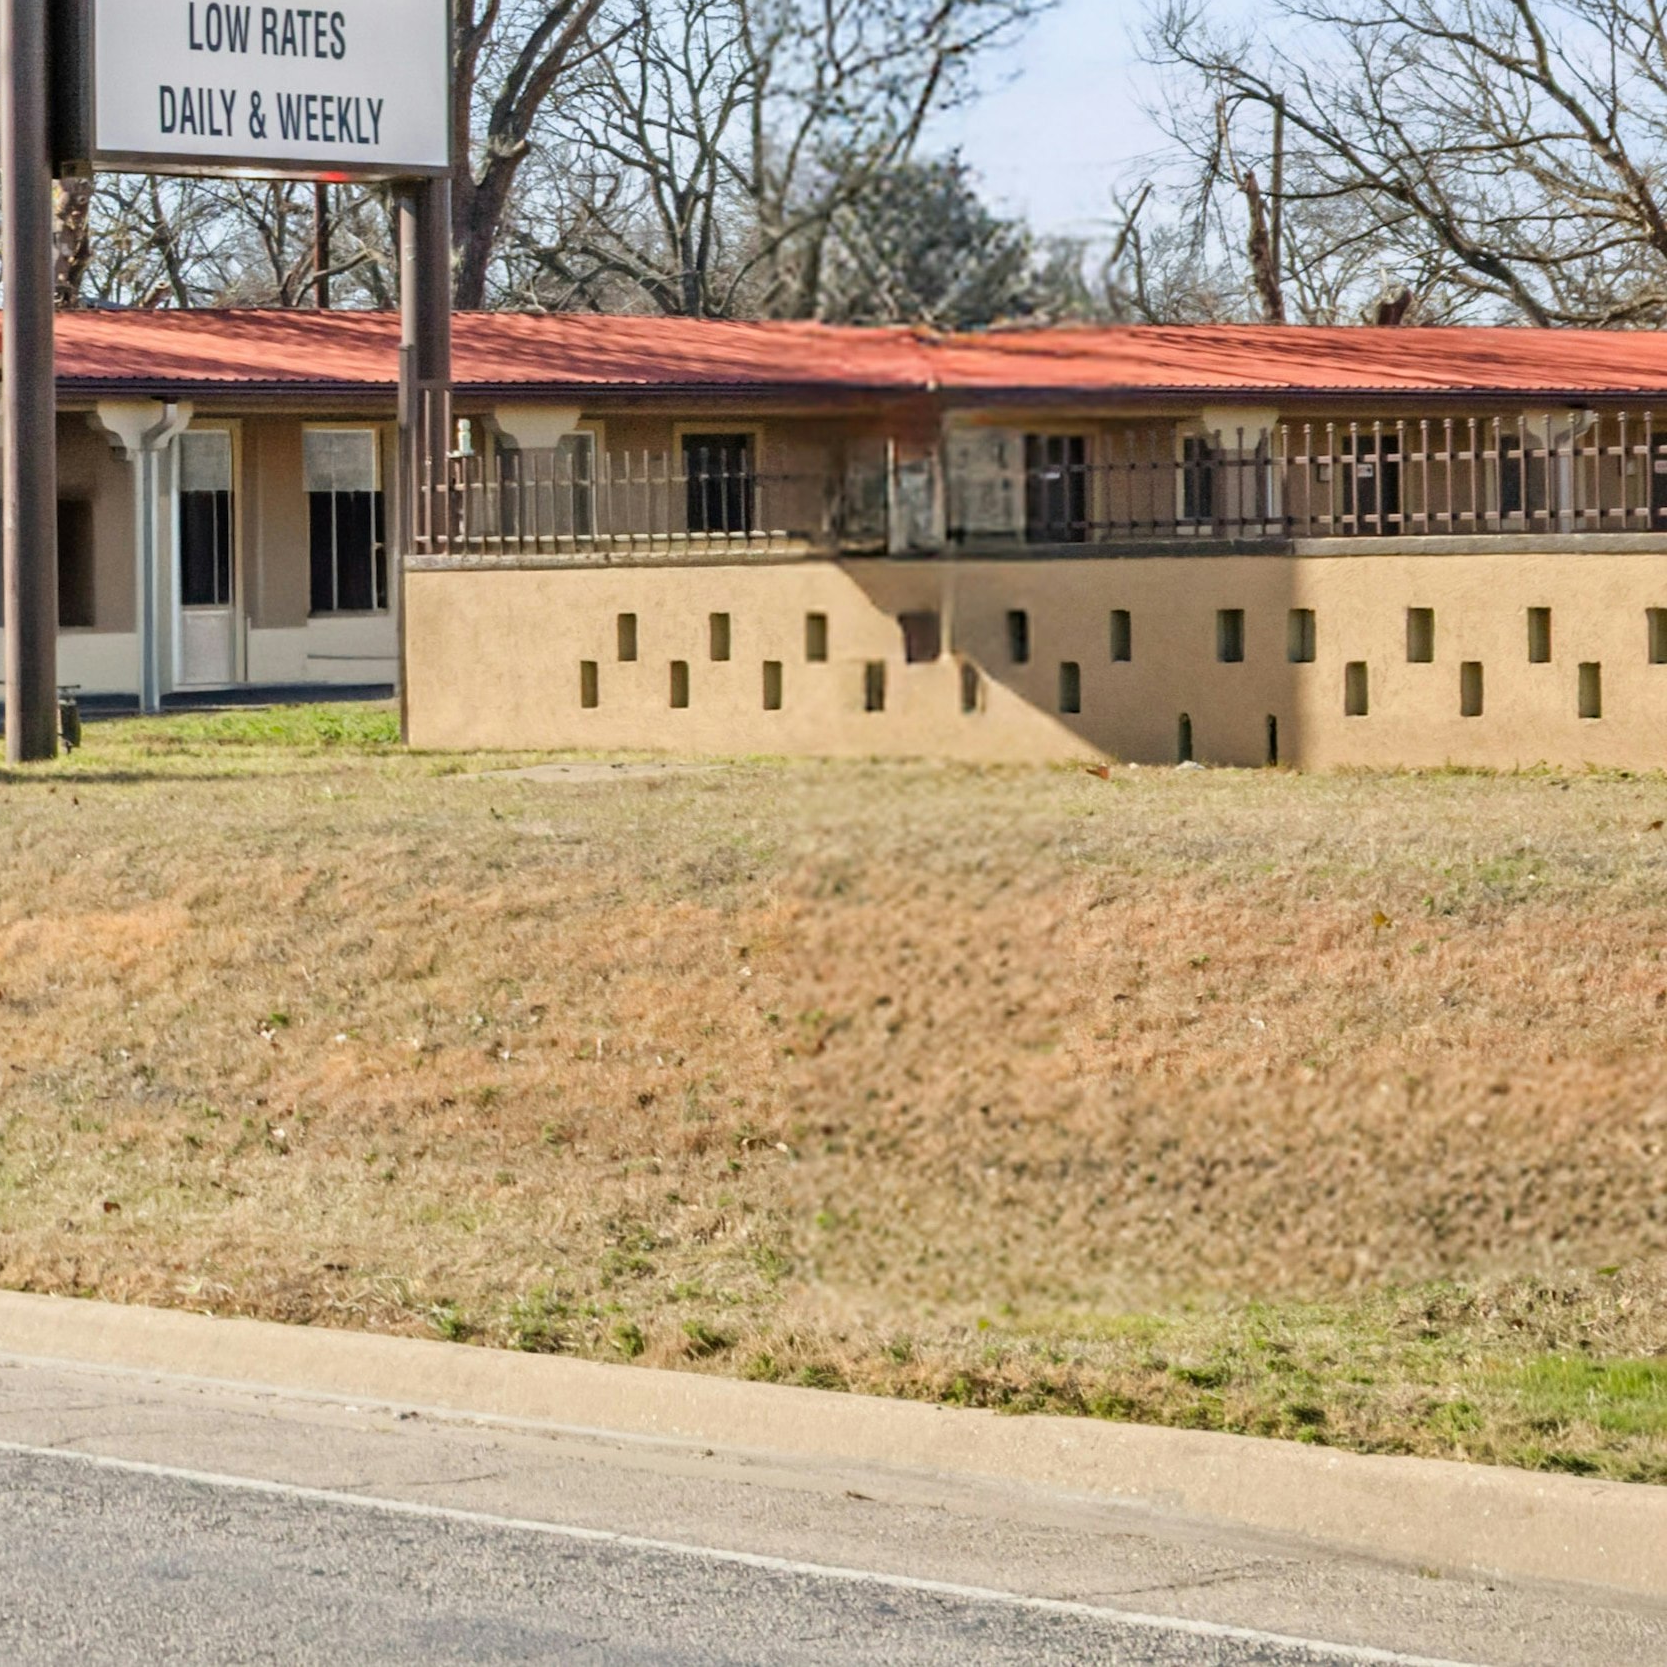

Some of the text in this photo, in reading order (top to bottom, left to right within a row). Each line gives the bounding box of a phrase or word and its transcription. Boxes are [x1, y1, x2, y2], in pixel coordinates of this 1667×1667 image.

[189, 1, 346, 60] LOW RATES
[159, 85, 384, 145] DAILY & WEEKLY
